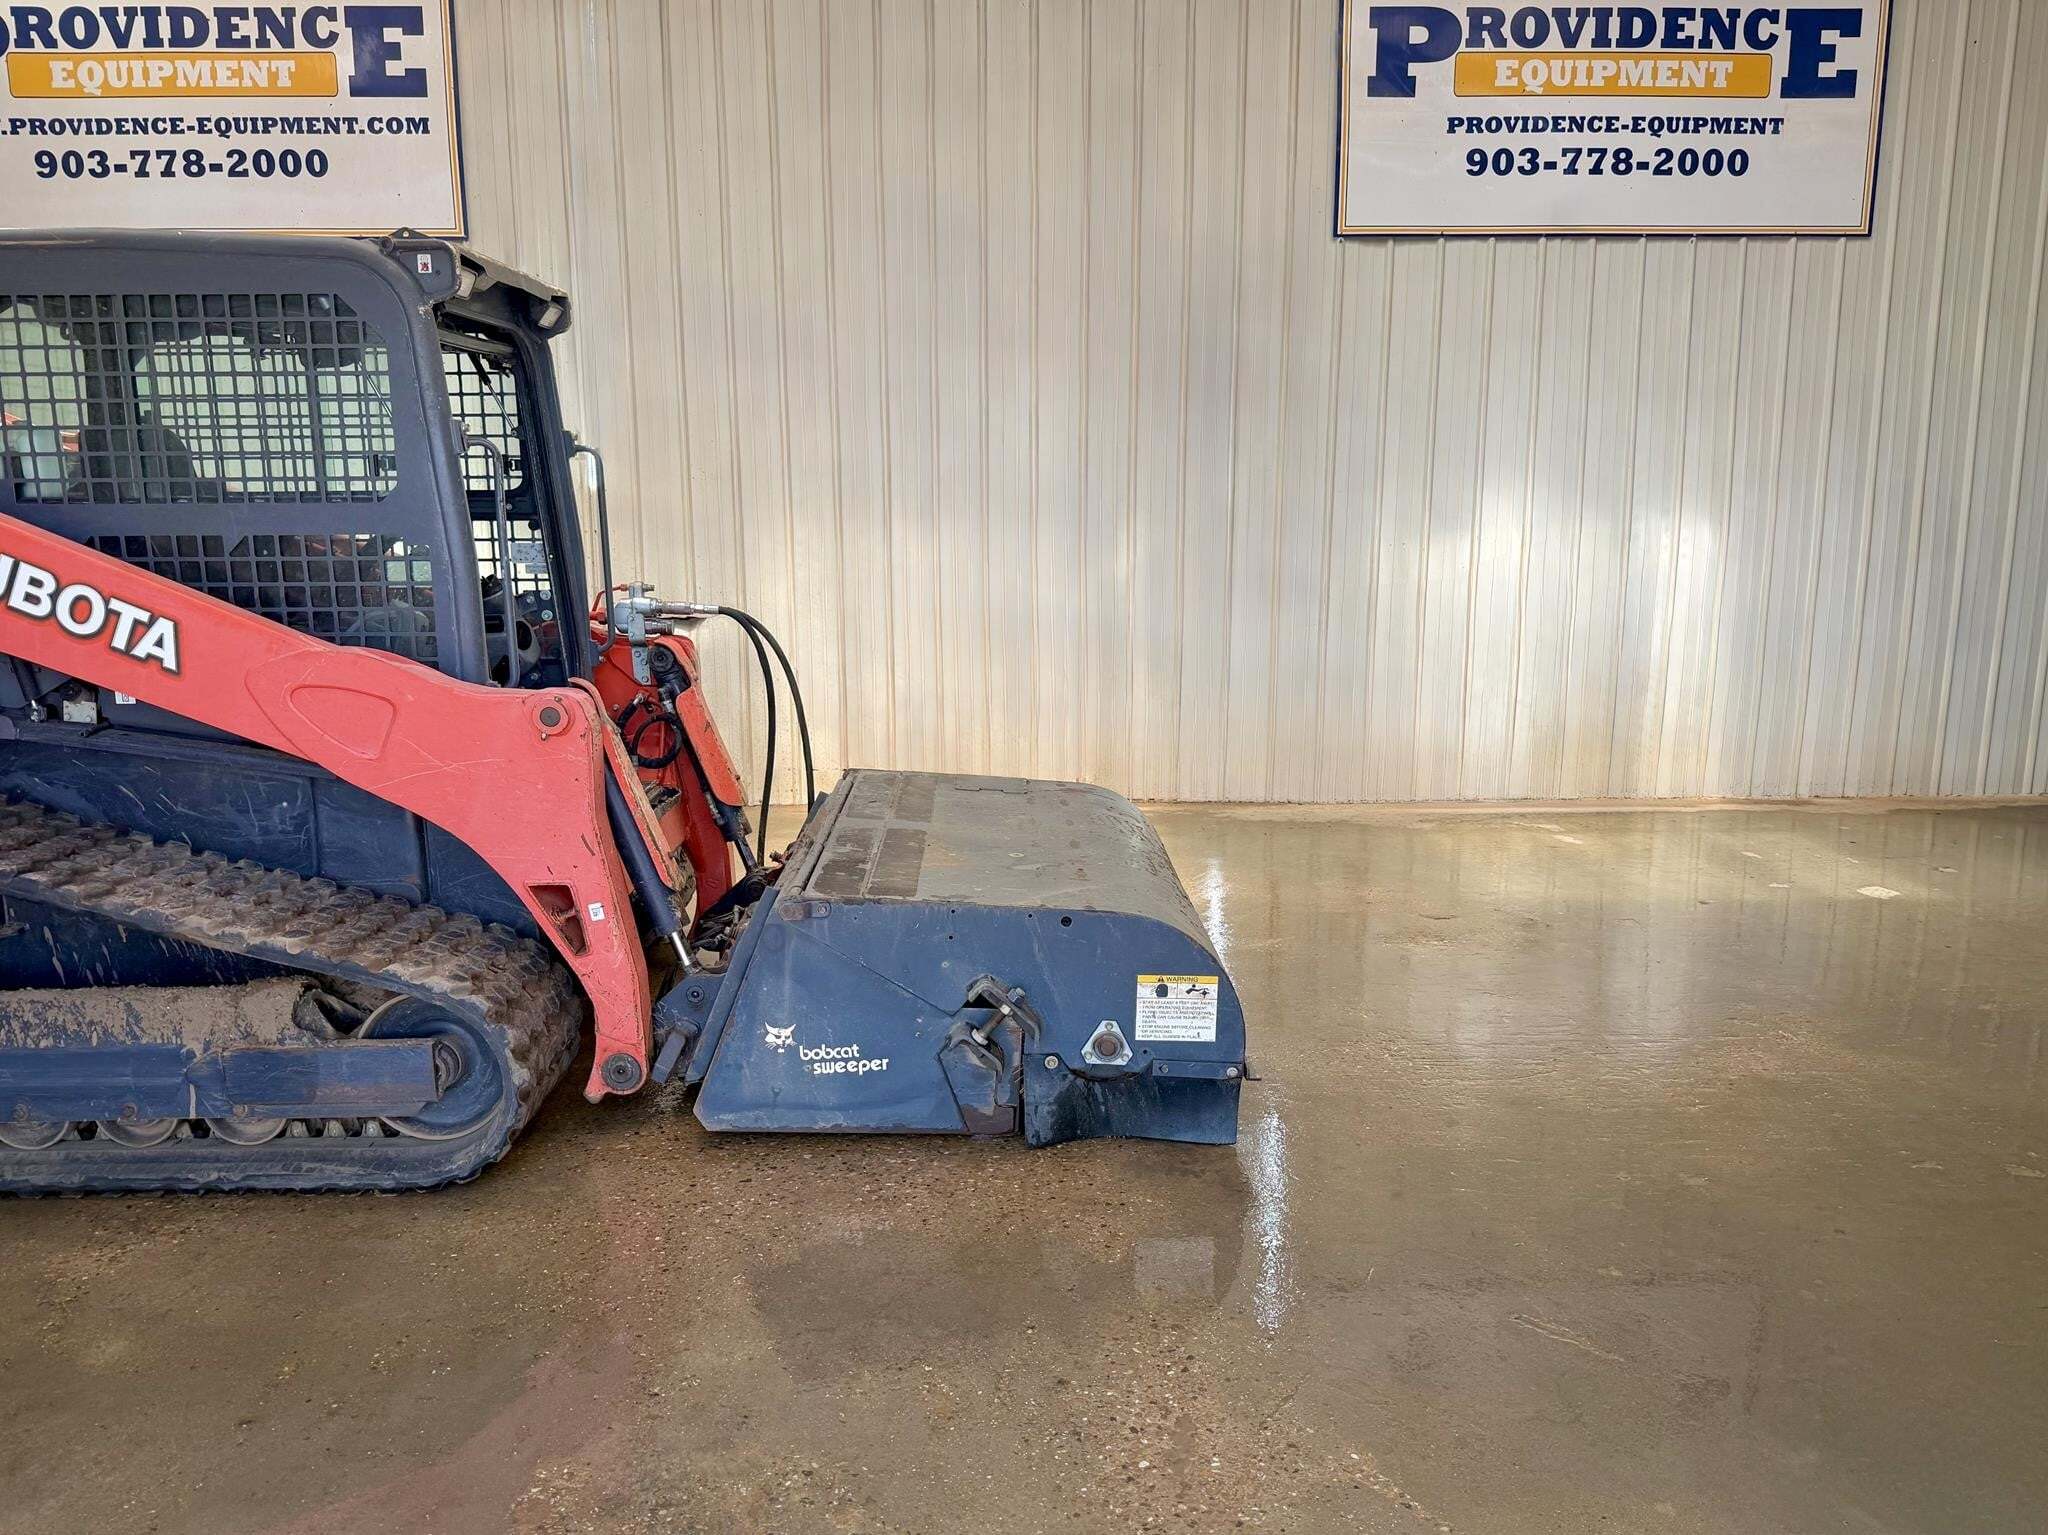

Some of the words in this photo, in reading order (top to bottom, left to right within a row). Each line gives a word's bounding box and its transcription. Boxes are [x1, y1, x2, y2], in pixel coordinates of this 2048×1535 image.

[0, 5, 428, 98] ROVIDENCE
[1367, 5, 1863, 98] PROVIDENCE
[49, 60, 296, 96] EQUIPMENT
[1494, 59, 1734, 93] EQUIPMENT
[0, 116, 431, 139] .PROVIDENCE-EQUIPMENT.COM
[1446, 115, 1785, 138] PROVIDENCE-EQUIPMENT
[34, 149, 329, 179] 903-778-2000
[1465, 147, 1749, 177] 903-778-2000
[799, 1043, 860, 1060] bobcat
[813, 1058, 889, 1076] sweeper
